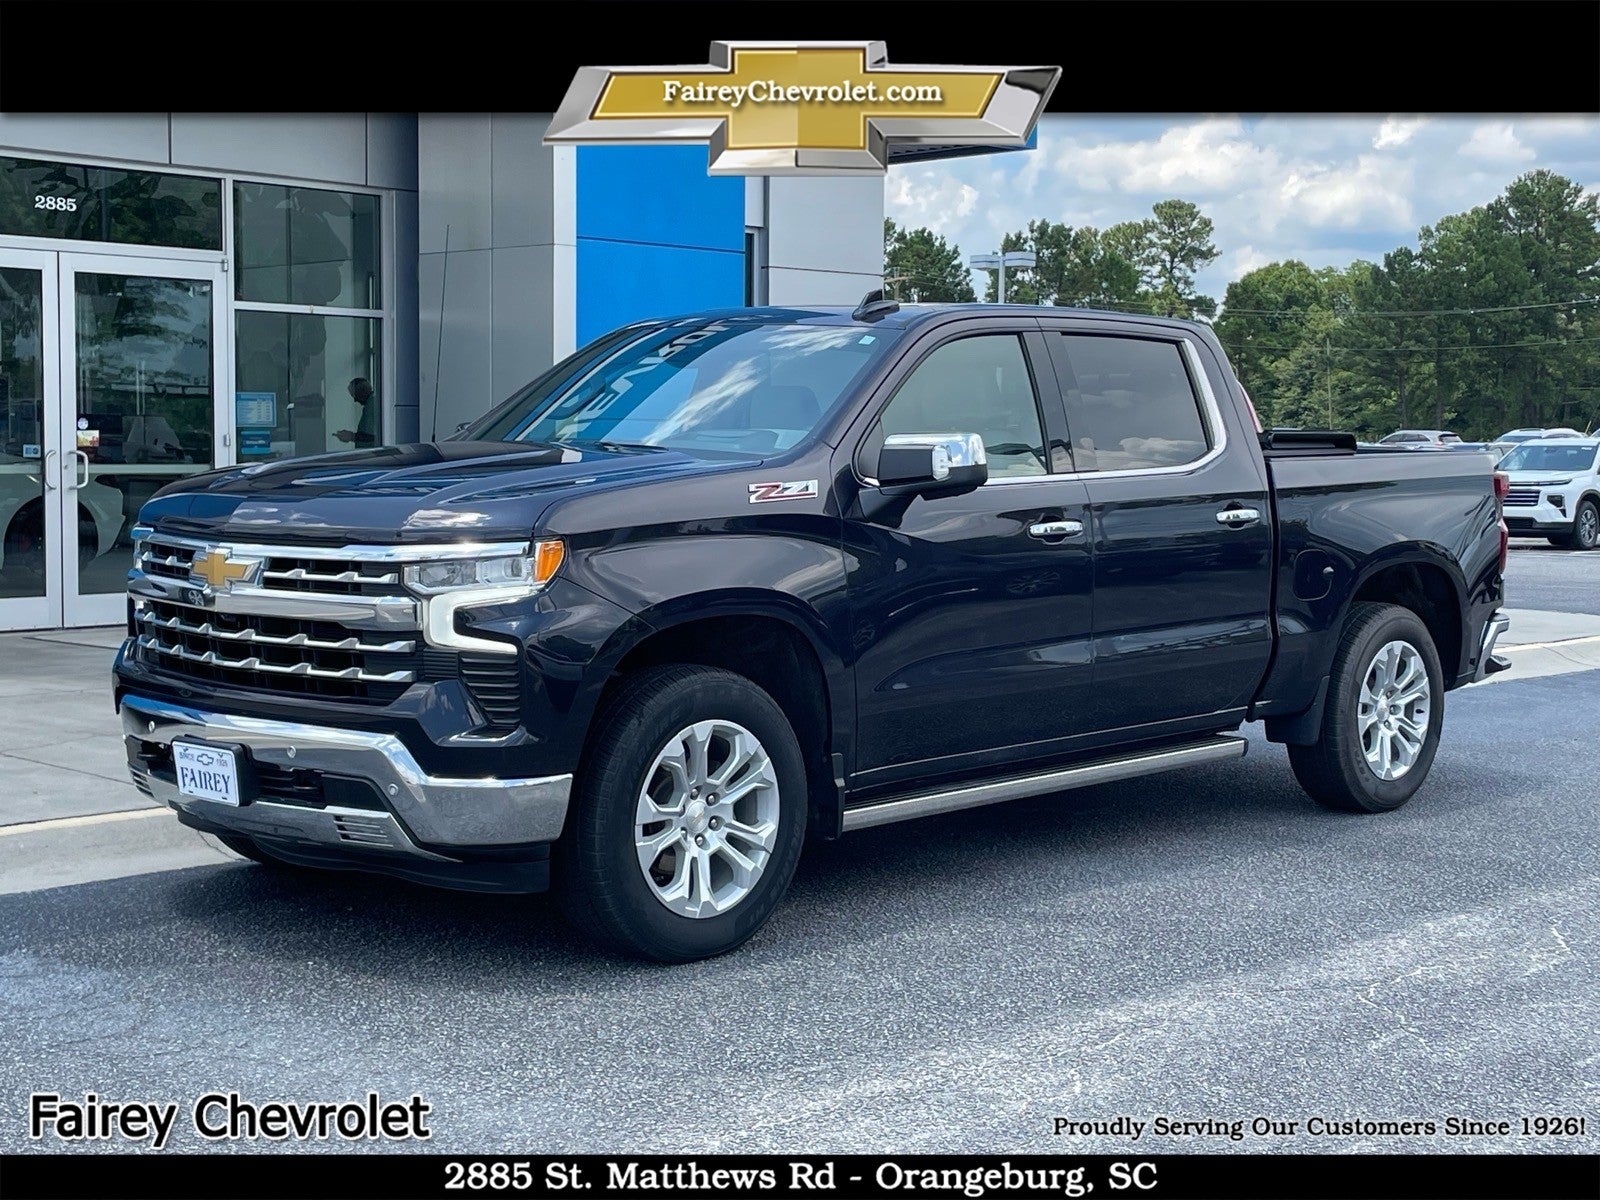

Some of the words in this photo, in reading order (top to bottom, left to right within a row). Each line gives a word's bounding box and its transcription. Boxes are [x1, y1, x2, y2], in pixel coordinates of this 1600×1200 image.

[34, 195, 77, 211] 2885
[748, 480, 818, 503] Z71
[180, 766, 230, 794] FAIREY
